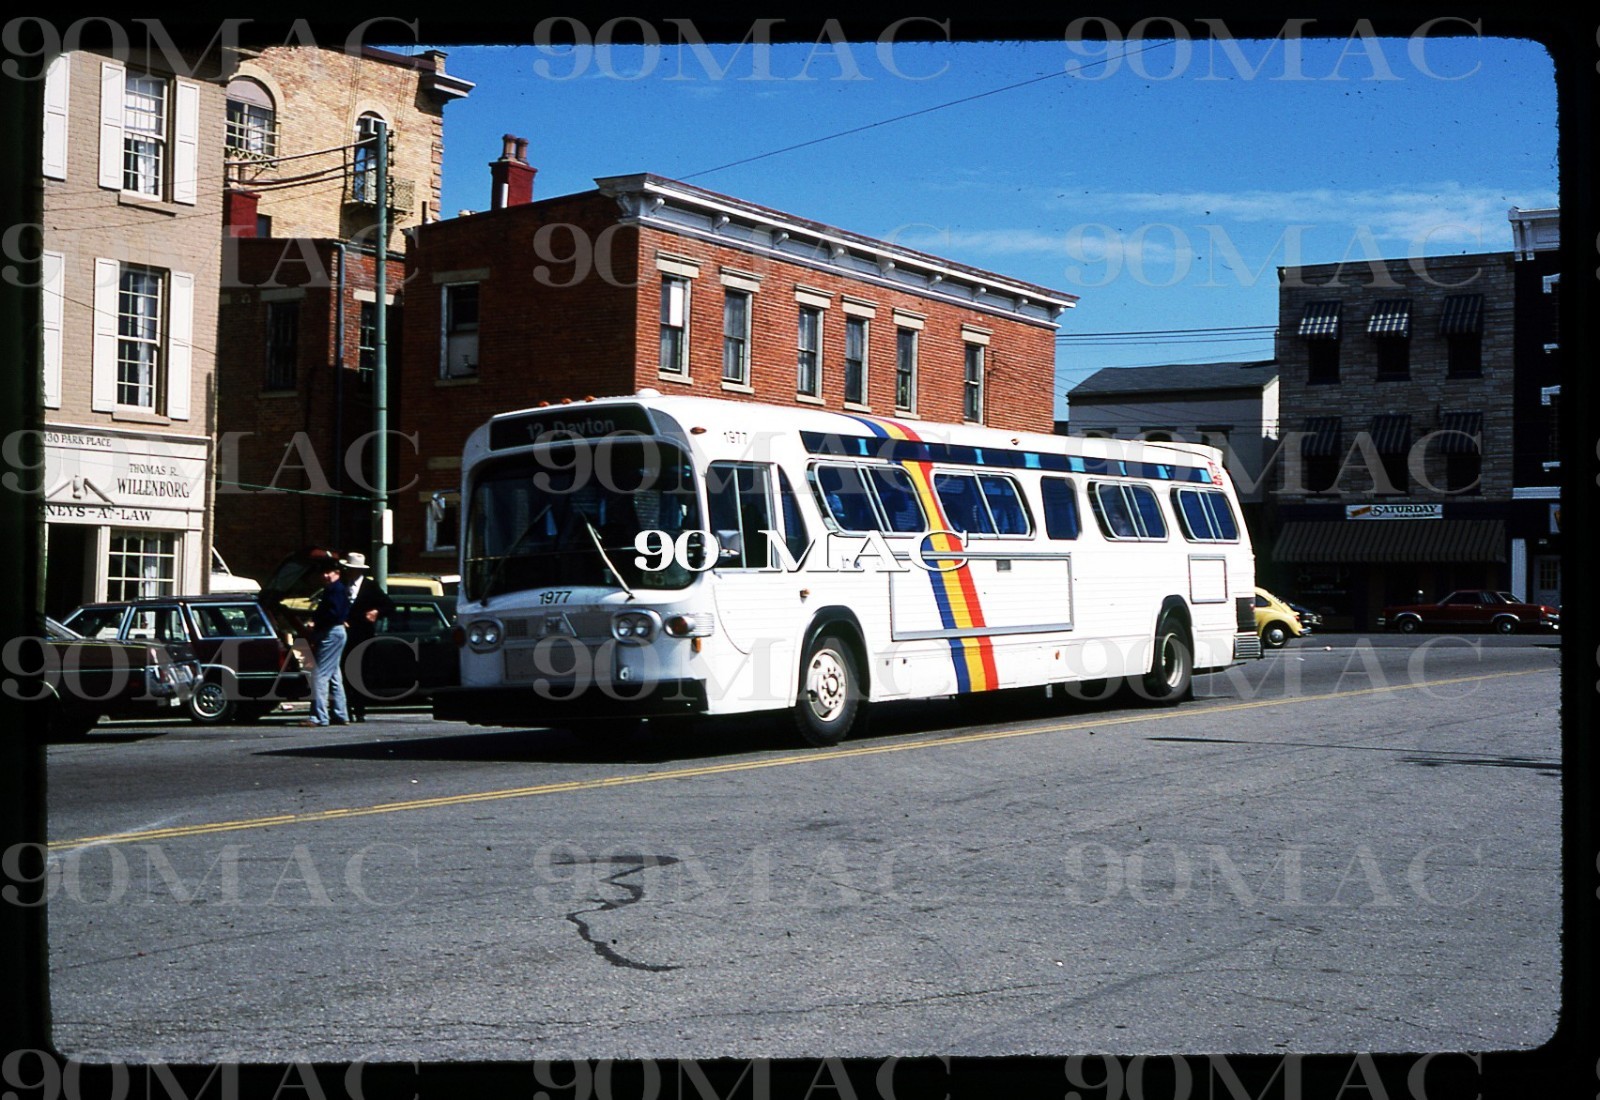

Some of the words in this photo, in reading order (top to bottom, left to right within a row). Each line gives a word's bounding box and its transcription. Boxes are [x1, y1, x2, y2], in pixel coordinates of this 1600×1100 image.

[525, 421, 544, 445] 12
[554, 416, 616, 437] Dayton
[61, 434, 84, 445] PARK
[86, 436, 112, 447] PLACE
[723, 431, 748, 445] 1977
[129, 463, 167, 476] THOMAS
[117, 478, 190, 498] WILLENBORG
[1371, 505, 1437, 517] SATURDAY
[539, 591, 572, 604] 1977
